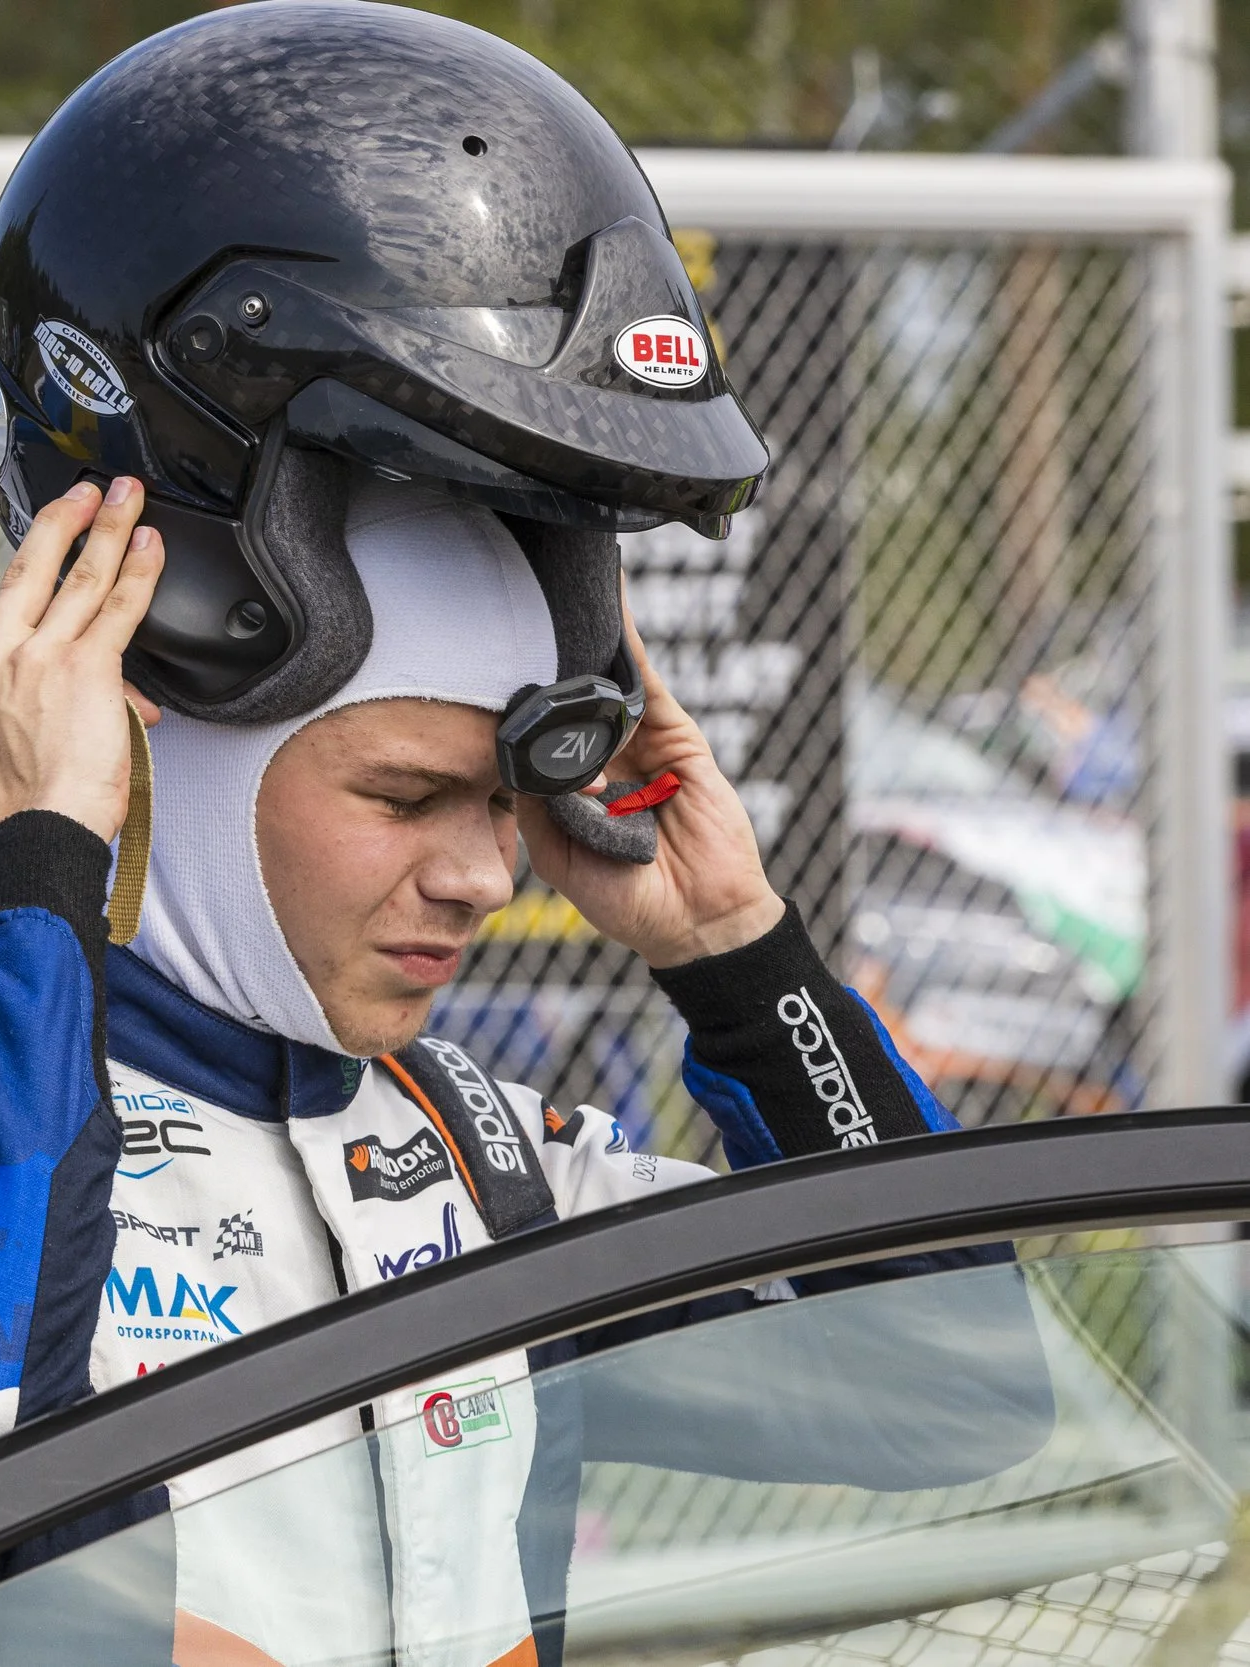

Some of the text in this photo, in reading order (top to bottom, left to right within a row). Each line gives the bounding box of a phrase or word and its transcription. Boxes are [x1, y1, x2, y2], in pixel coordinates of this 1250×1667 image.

[33, 321, 134, 414] MAG-10 RALLY
[62, 327, 111, 372] CARBON
[632, 333, 700, 367] BELL
[52, 368, 92, 408] SERIES
[644, 366, 694, 377] HELMETS
[417, 1037, 521, 1172] sparco
[400, 1158, 445, 1190] emotion
[110, 1209, 200, 1247] SPORT
